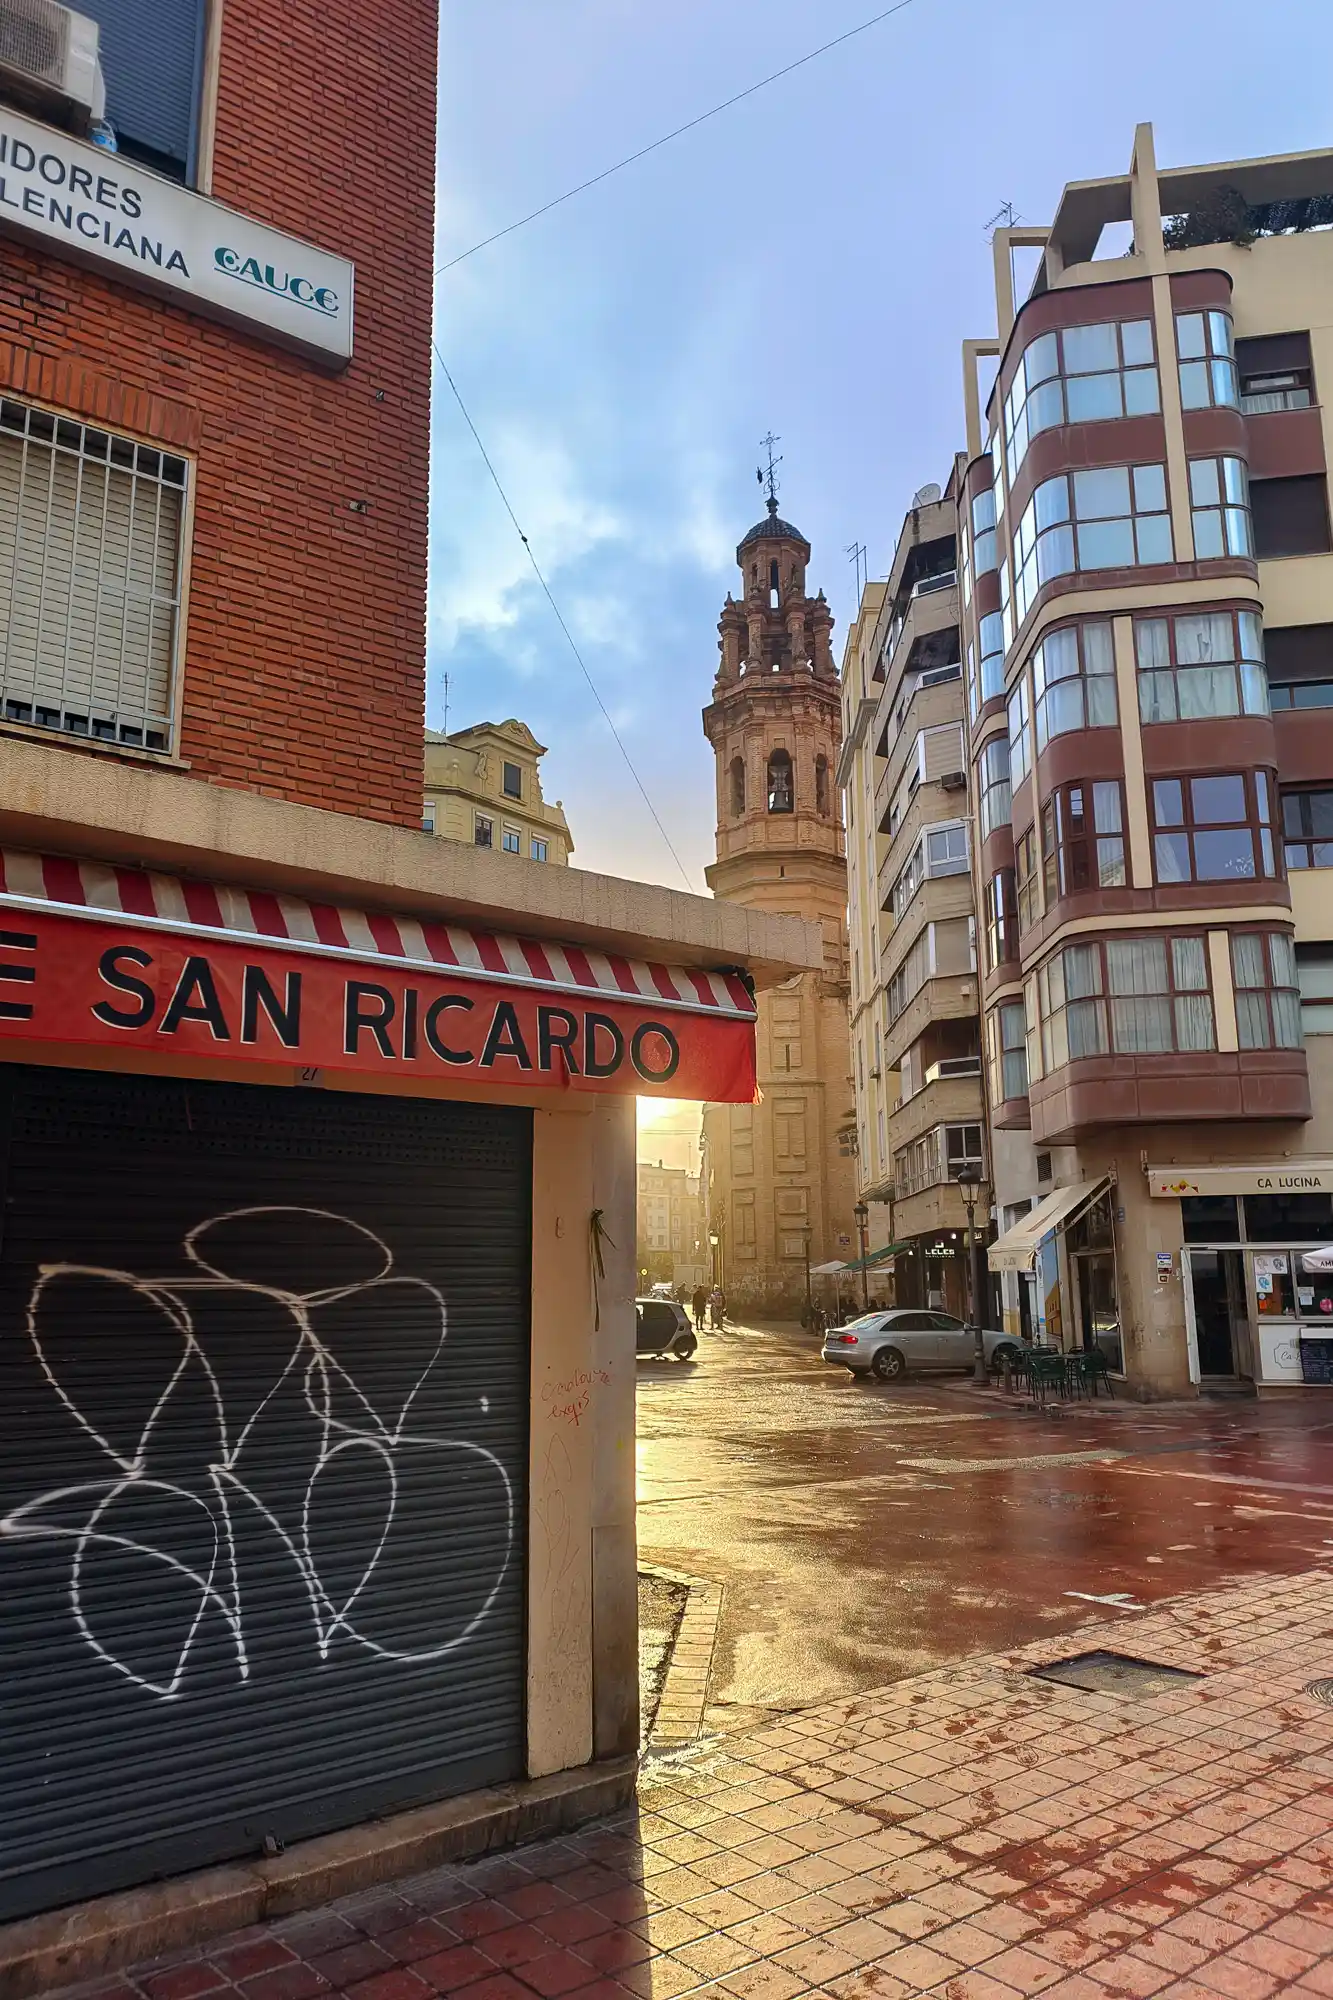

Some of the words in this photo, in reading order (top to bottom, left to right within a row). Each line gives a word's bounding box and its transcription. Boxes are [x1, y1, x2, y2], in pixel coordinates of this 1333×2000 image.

[0, 134, 142, 218] IDORES
[0, 176, 191, 279] LENCIANA
[214, 247, 339, 312] CAUCE
[90, 945, 302, 1049] SAN
[343, 980, 680, 1084] RICARDO
[1257, 1178, 1273, 1188] CA
[1278, 1177, 1322, 1188] LUCINA
